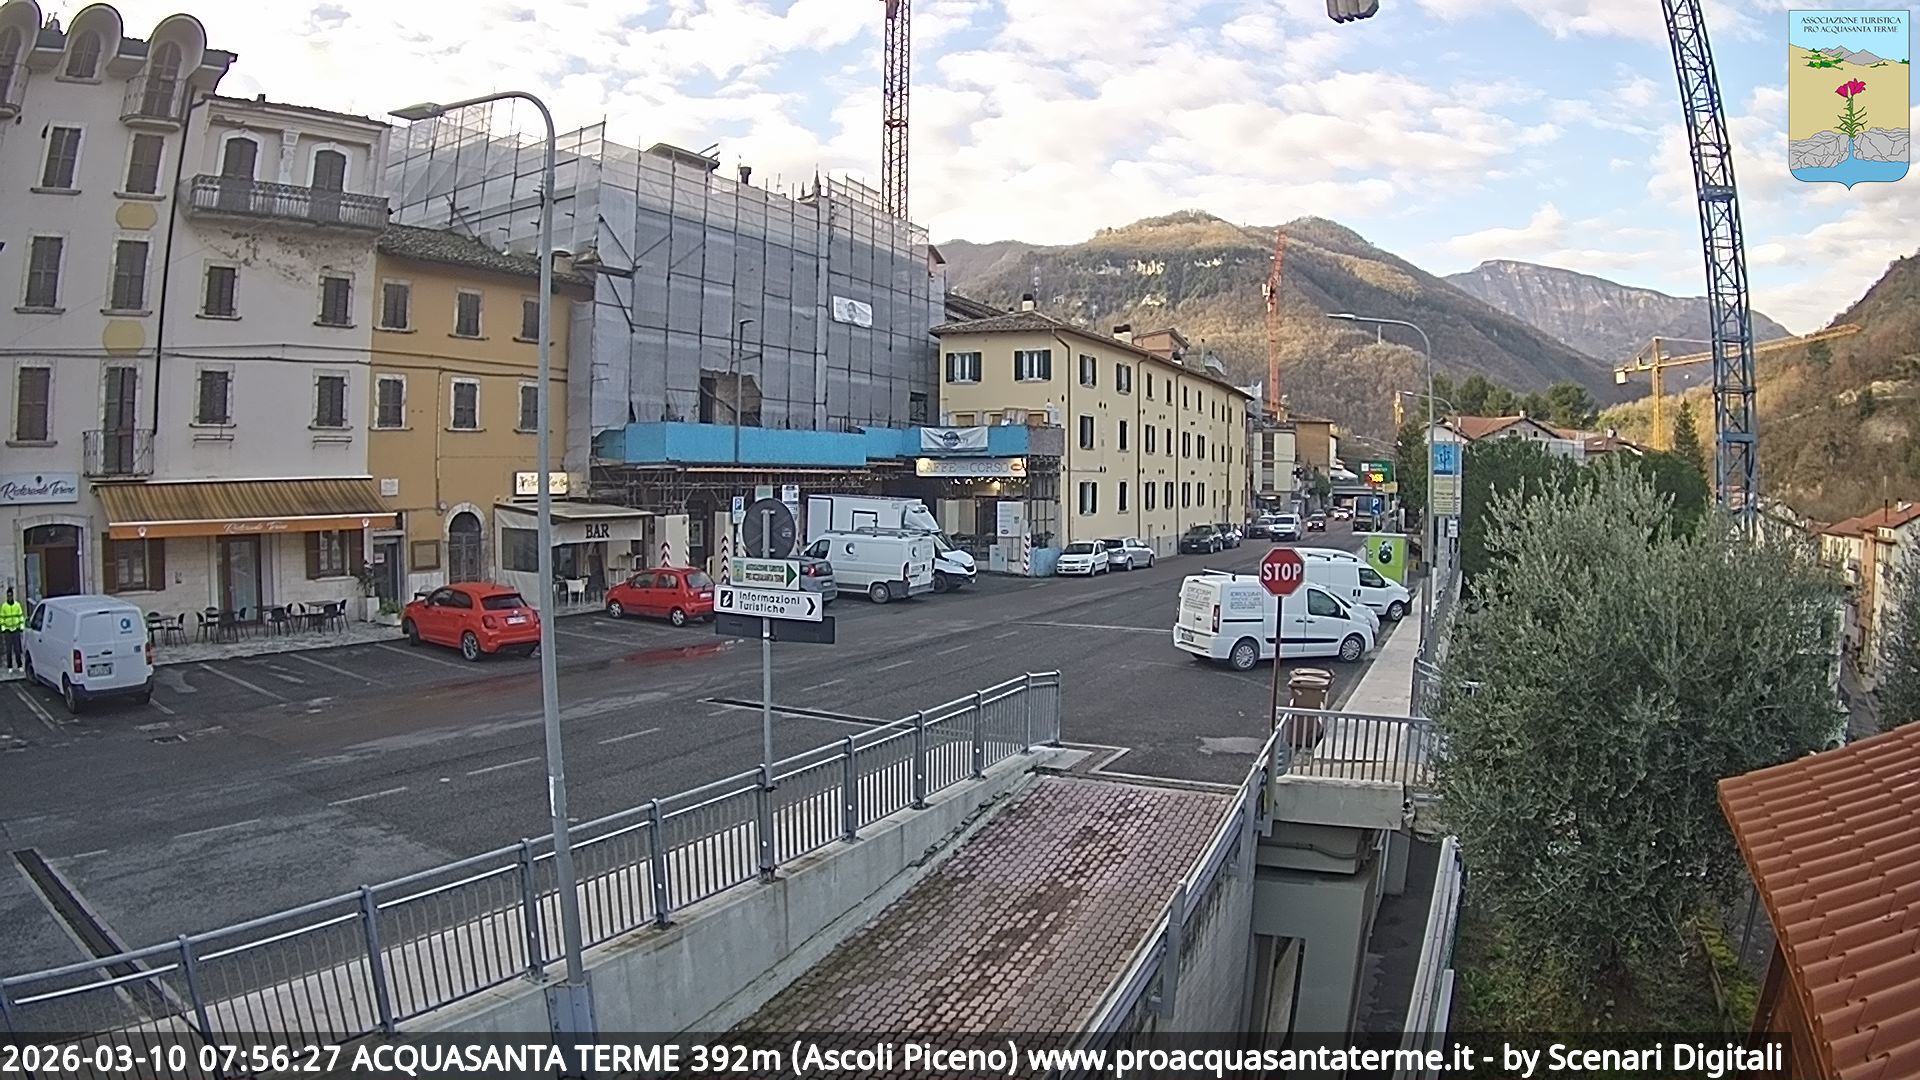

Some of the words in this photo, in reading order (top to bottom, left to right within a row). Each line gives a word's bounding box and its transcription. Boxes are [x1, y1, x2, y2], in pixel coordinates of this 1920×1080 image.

[969, 462, 1009, 473] CORSO
[585, 523, 610, 539] BAR
[1263, 563, 1302, 582] STOP
[739, 591, 801, 605] Informazioni
[739, 601, 786, 614] Turistiche
